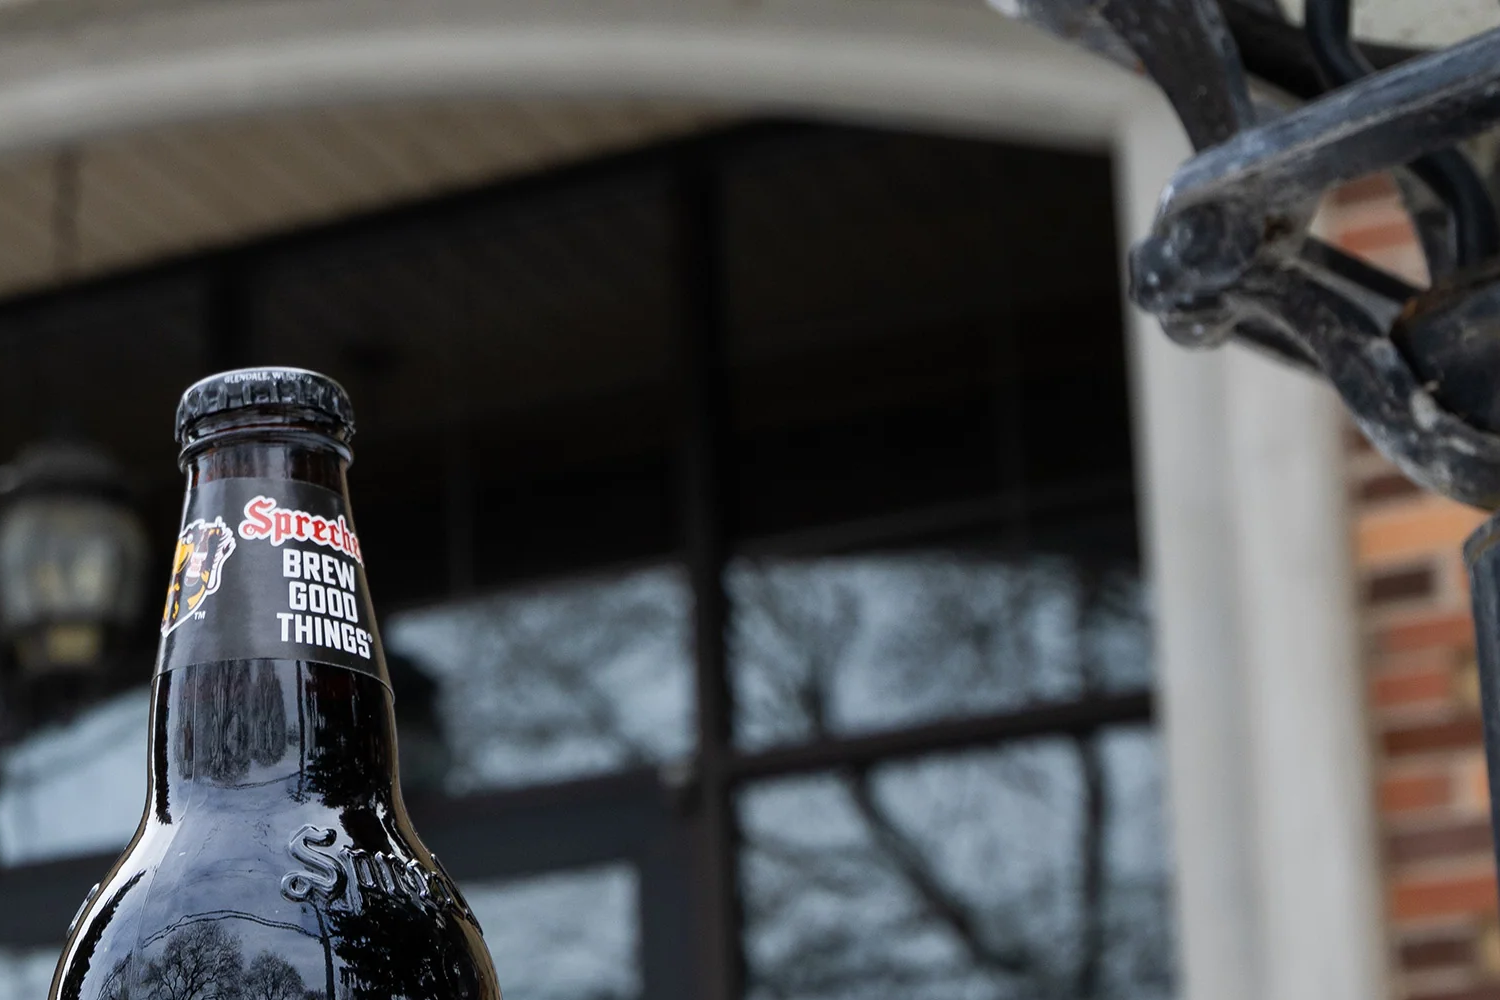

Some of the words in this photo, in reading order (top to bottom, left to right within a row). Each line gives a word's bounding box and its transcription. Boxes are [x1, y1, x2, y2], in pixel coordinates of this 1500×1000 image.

[239, 496, 363, 566] Spreche
[283, 548, 355, 592] BREW
[288, 581, 359, 624] GOOD
